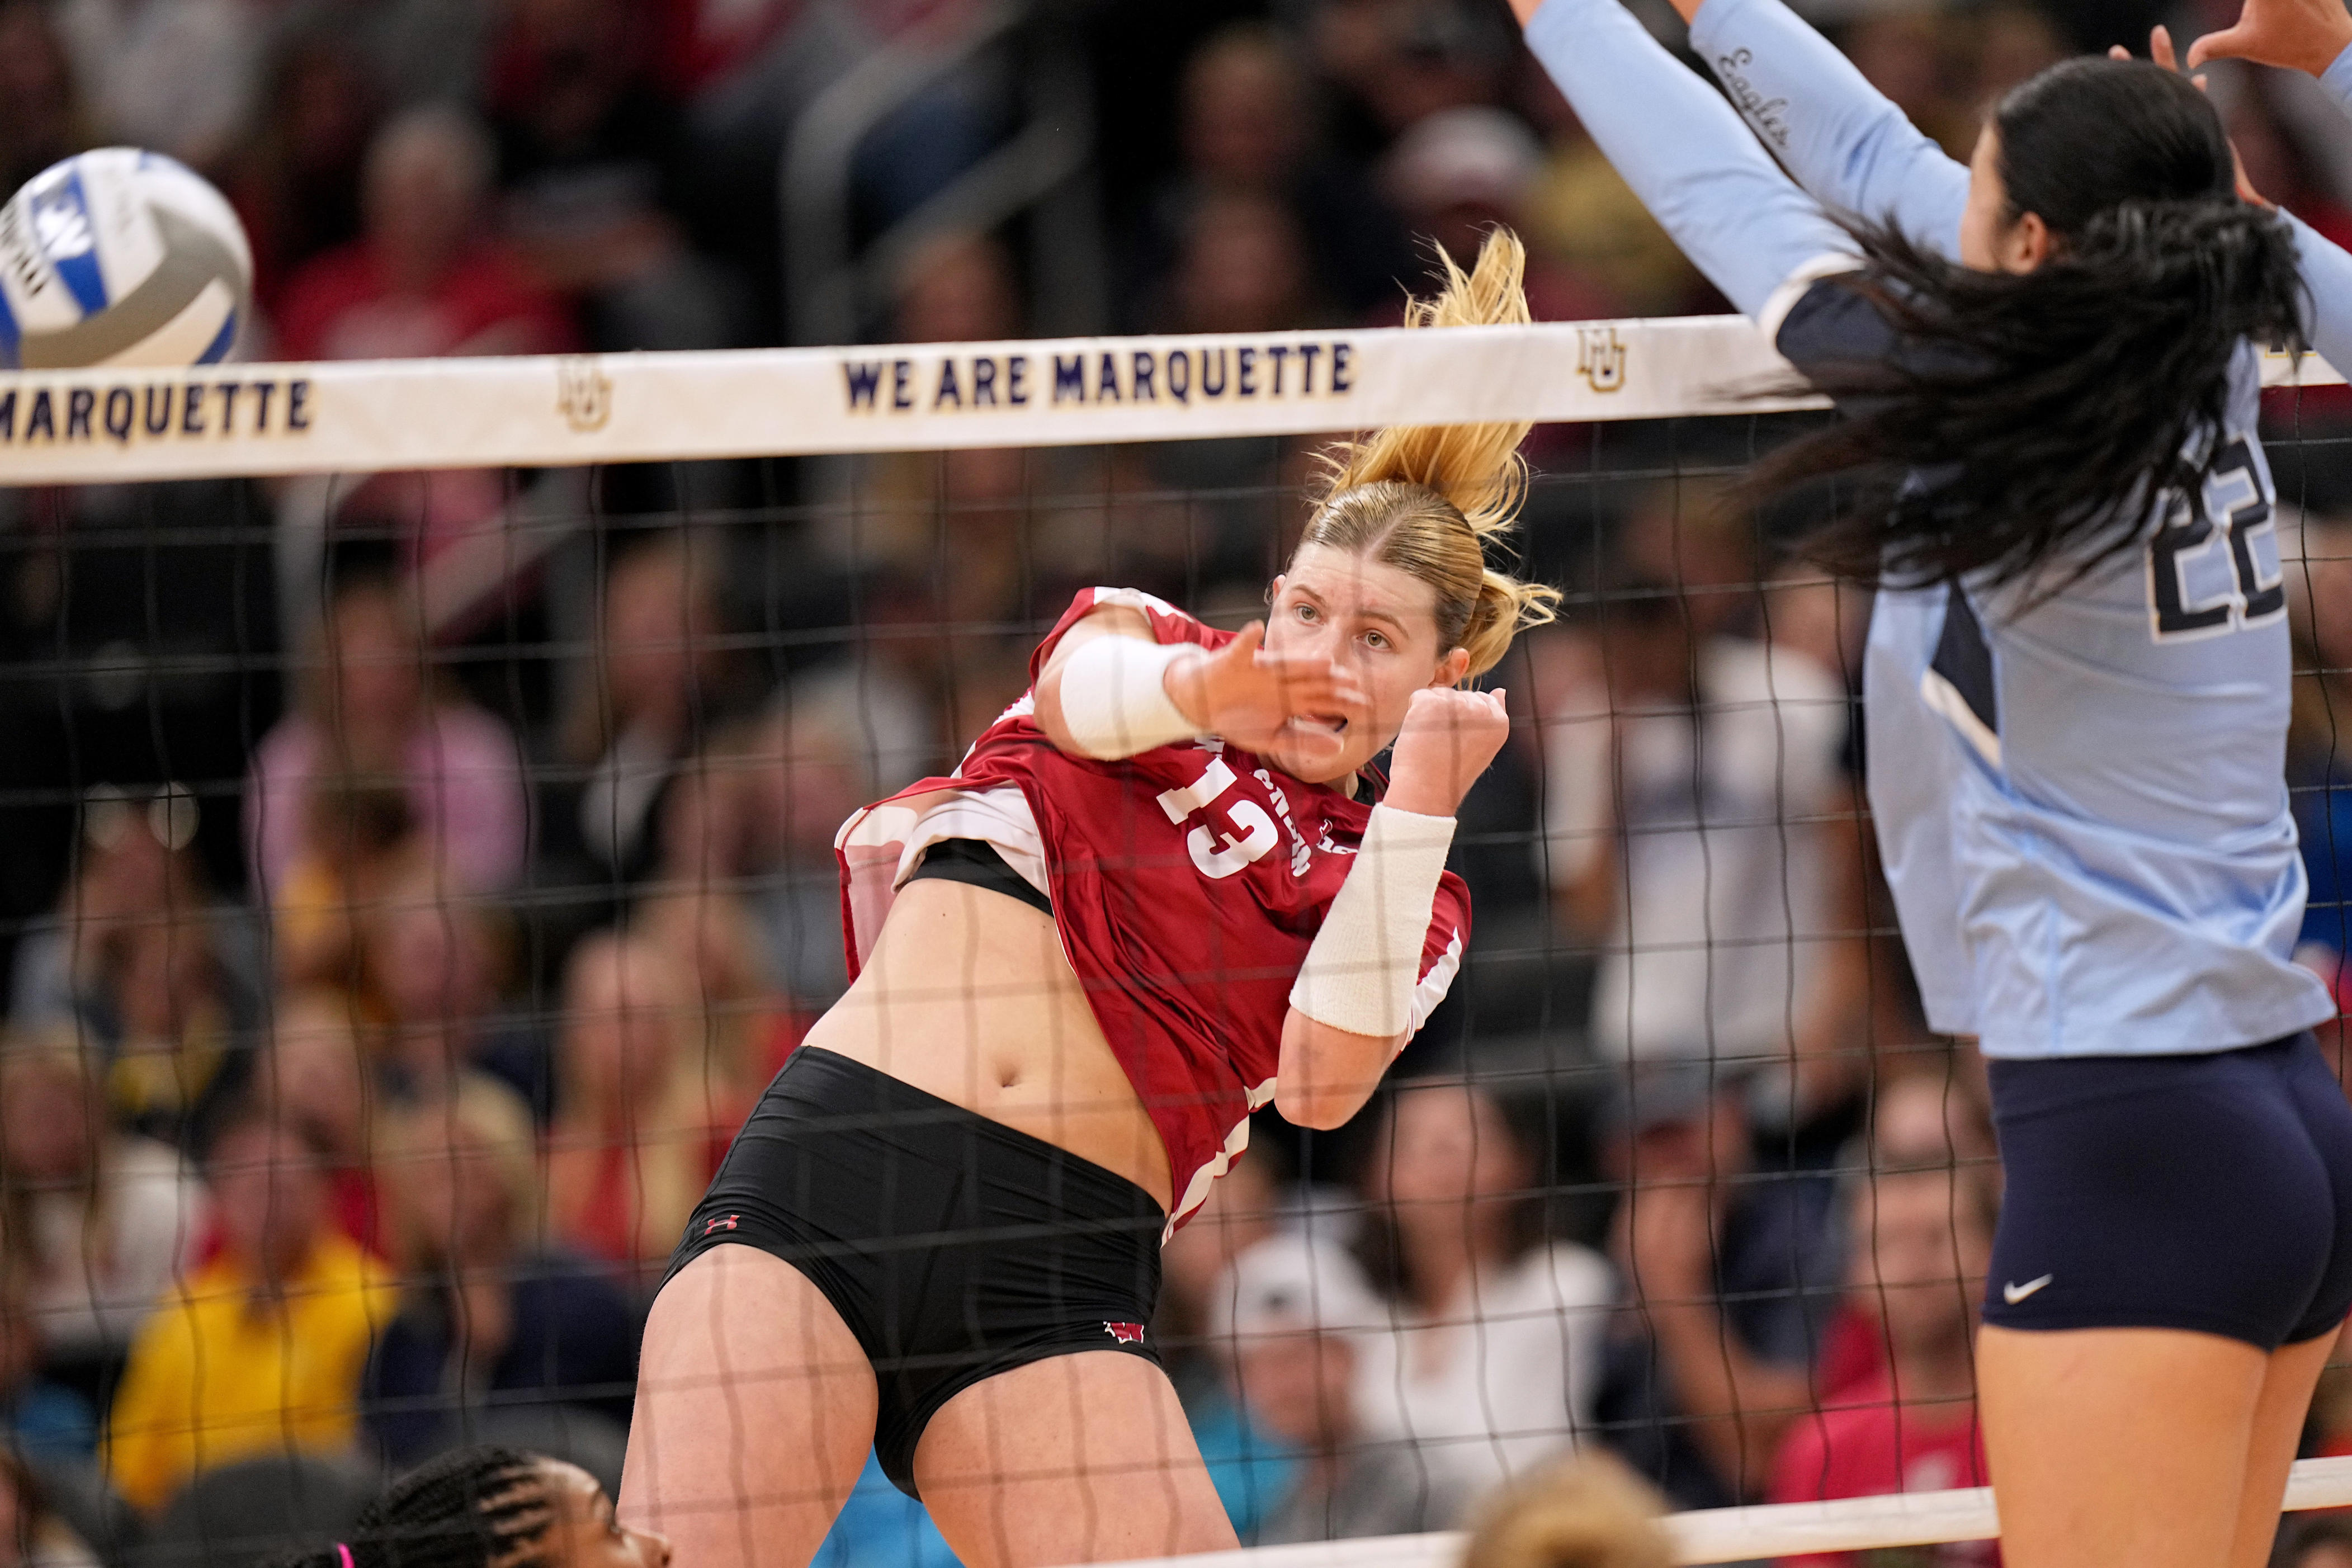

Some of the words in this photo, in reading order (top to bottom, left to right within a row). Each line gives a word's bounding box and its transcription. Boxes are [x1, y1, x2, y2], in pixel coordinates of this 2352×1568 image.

[1718, 46, 1789, 148] Eagles
[843, 358, 911, 409] WE
[934, 356, 1027, 410] ARE
[1054, 342, 1352, 404] MARQUETTE
[2146, 429, 2289, 645] 22
[1156, 757, 1279, 880] 13
